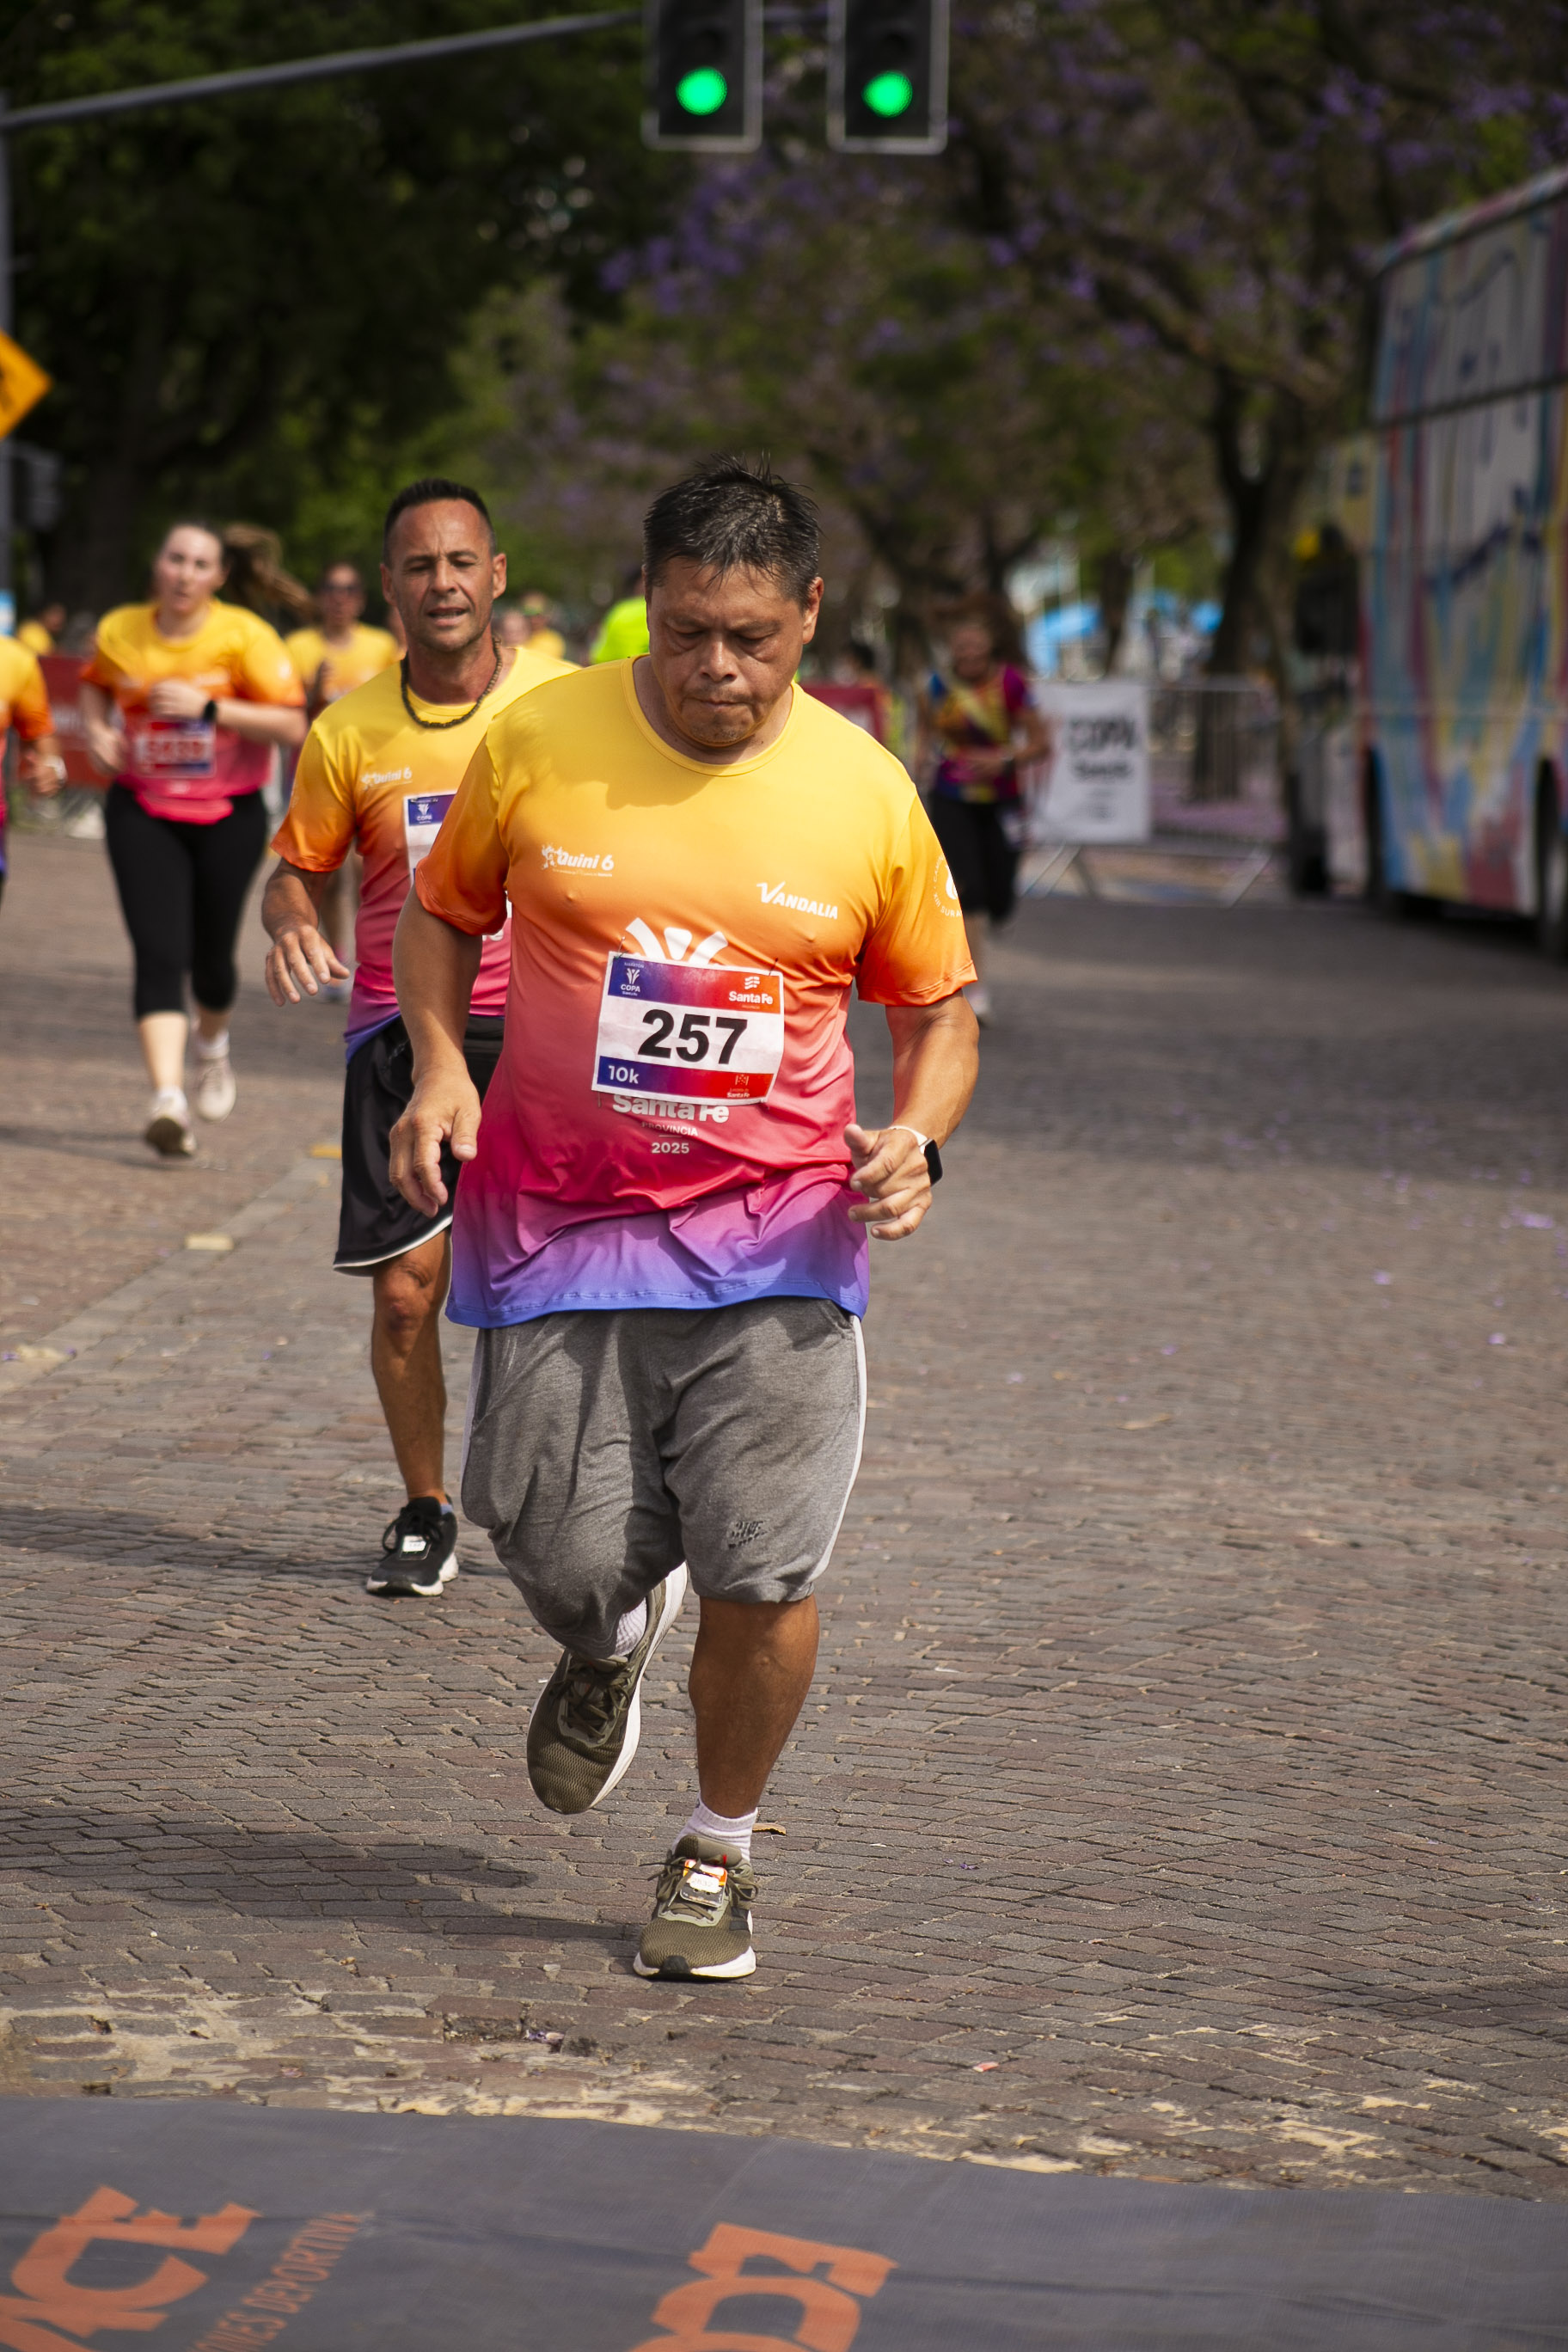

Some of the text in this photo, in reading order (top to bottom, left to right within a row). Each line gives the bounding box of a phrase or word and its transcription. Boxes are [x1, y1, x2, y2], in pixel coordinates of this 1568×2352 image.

[403, 768, 413, 779] 6
[557, 851, 615, 871] Quini 6
[756, 880, 838, 920] VANDALIA
[621, 983, 640, 993] COPA
[729, 990, 773, 1005] Santa Fe
[638, 1009, 748, 1065] 257
[609, 1065, 639, 1084] 10k
[613, 1094, 695, 1121] Santa
[641, 1122, 698, 1136] PROVINCIA
[652, 1142, 689, 1154] 2025
